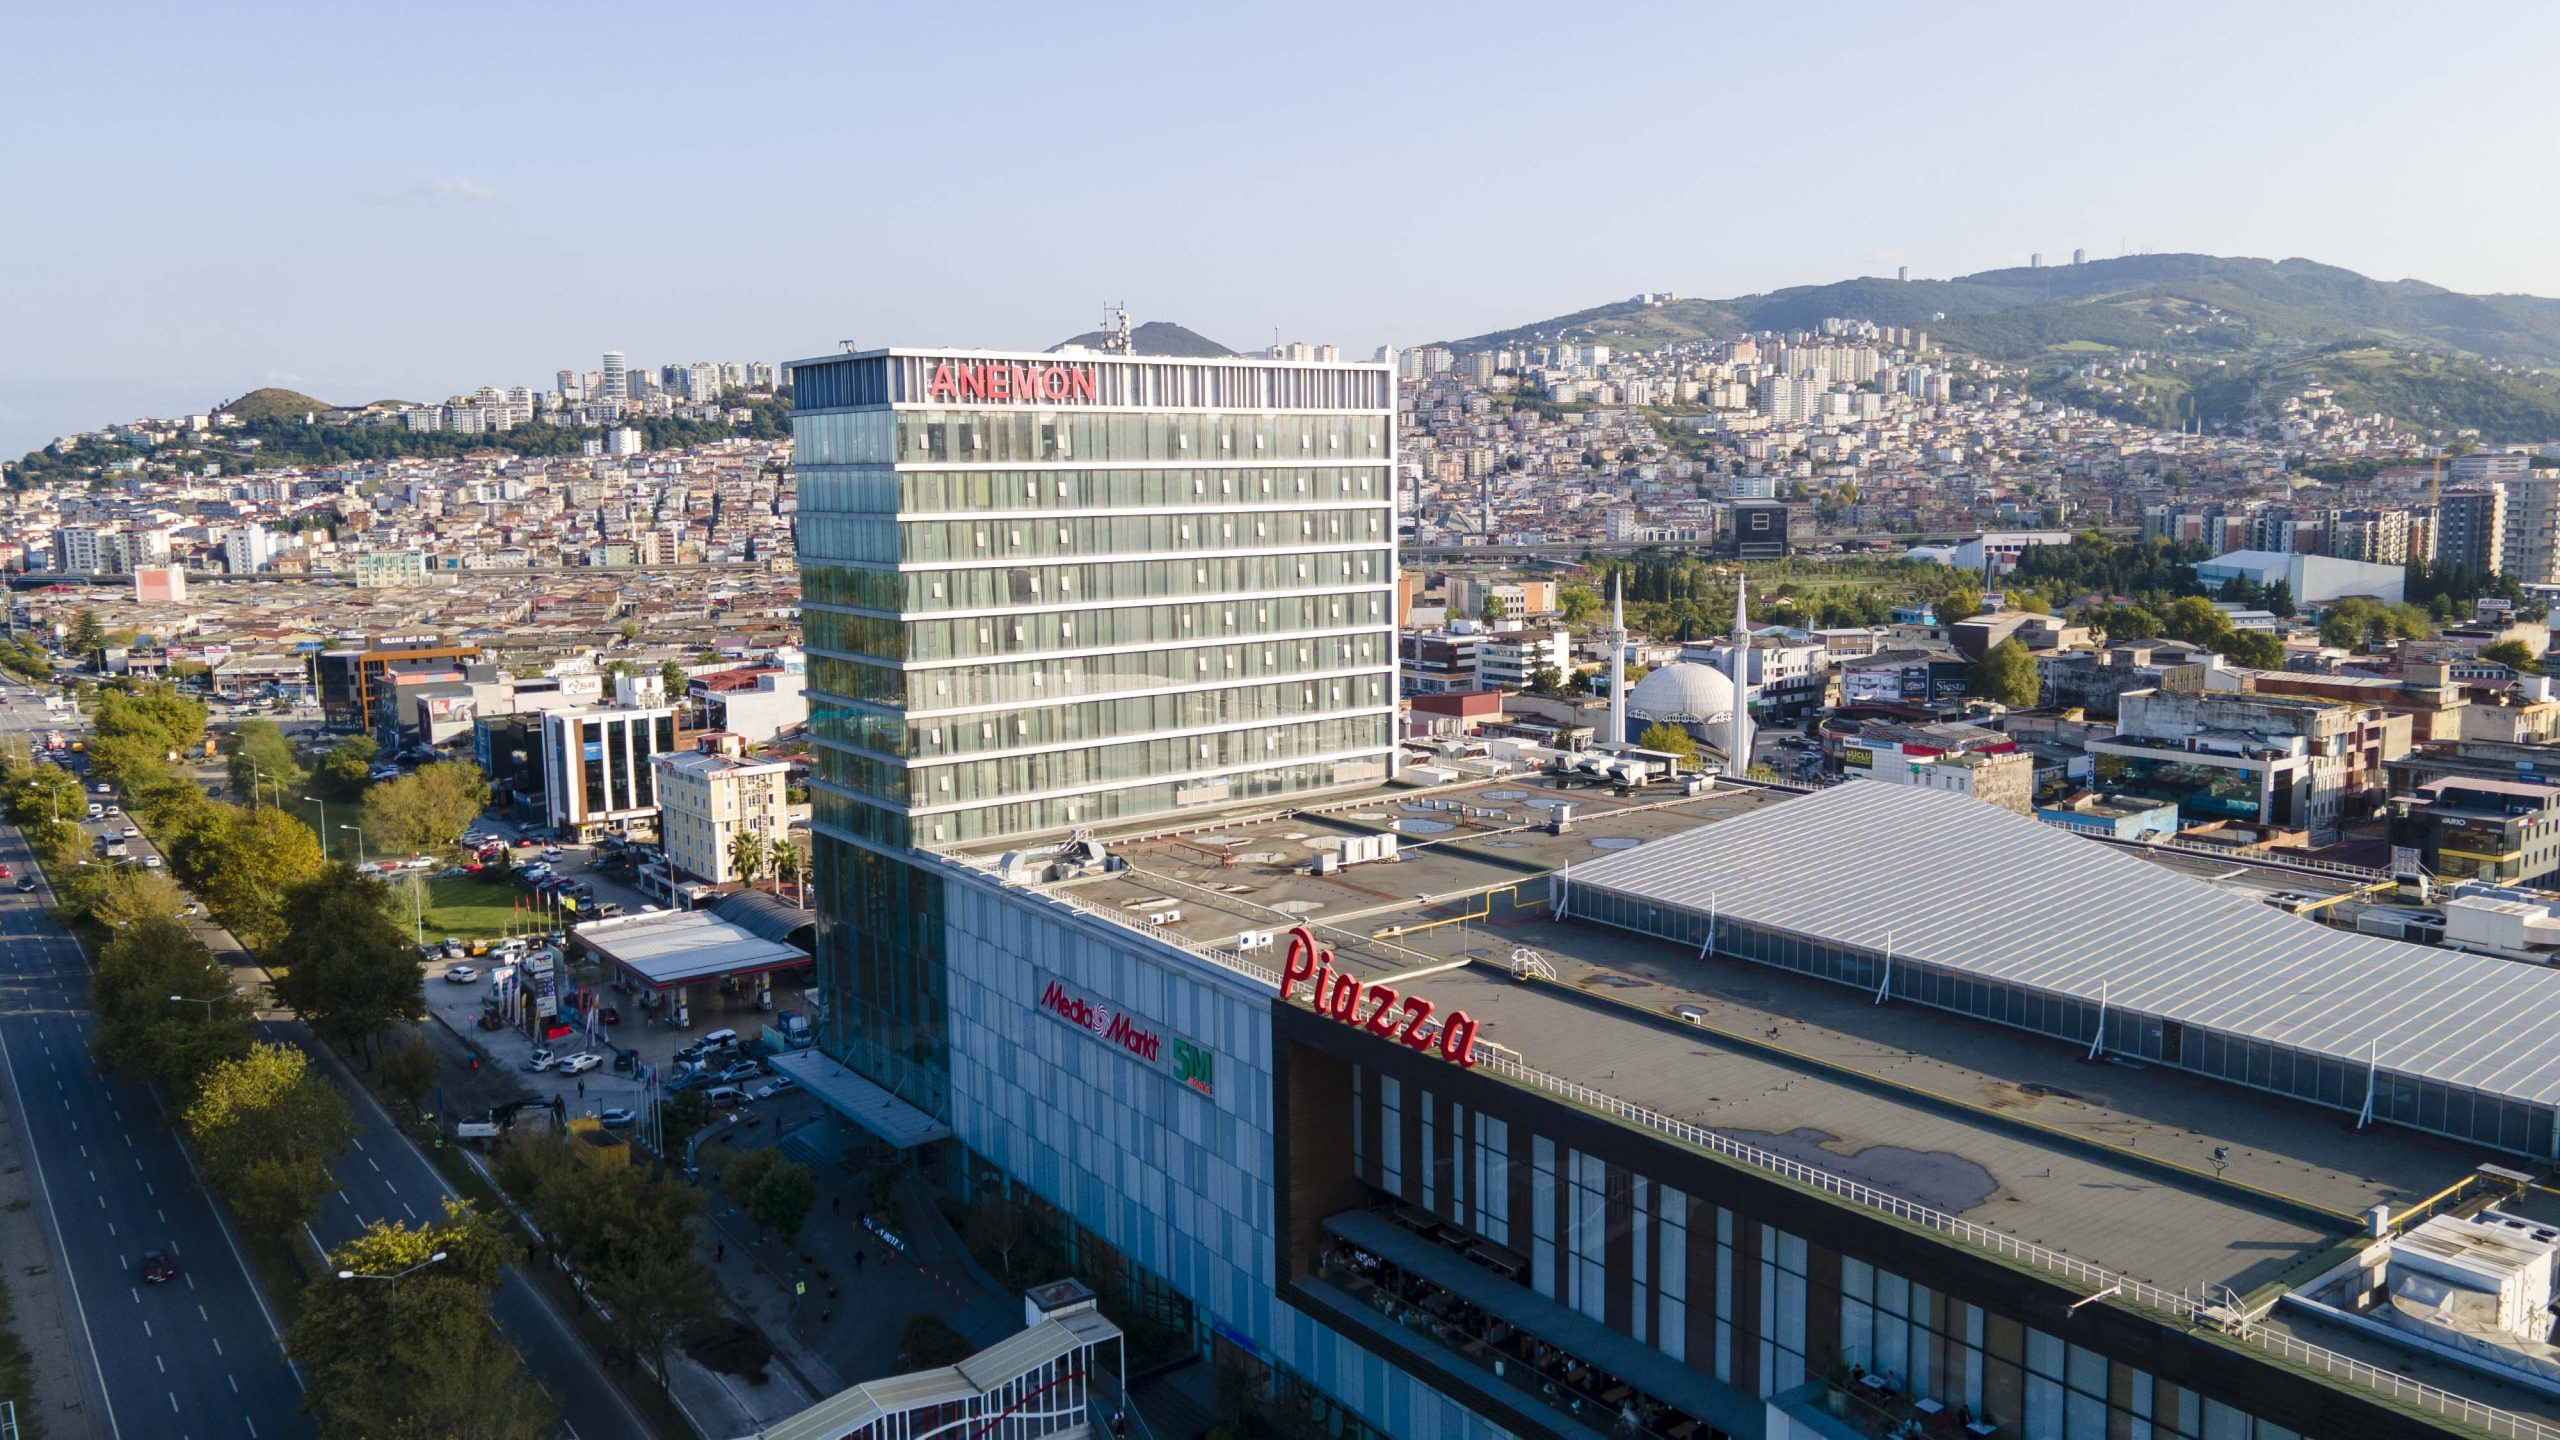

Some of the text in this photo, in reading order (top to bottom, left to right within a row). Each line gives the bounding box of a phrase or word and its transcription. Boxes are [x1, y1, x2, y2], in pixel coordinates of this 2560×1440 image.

[930, 363, 1096, 400] ANEMON
[1936, 681, 1966, 691] Siesta
[1041, 980, 1162, 1062] Media Markt
[1280, 927, 1479, 1069] Piazza
[1173, 1037, 1213, 1086] 5M
